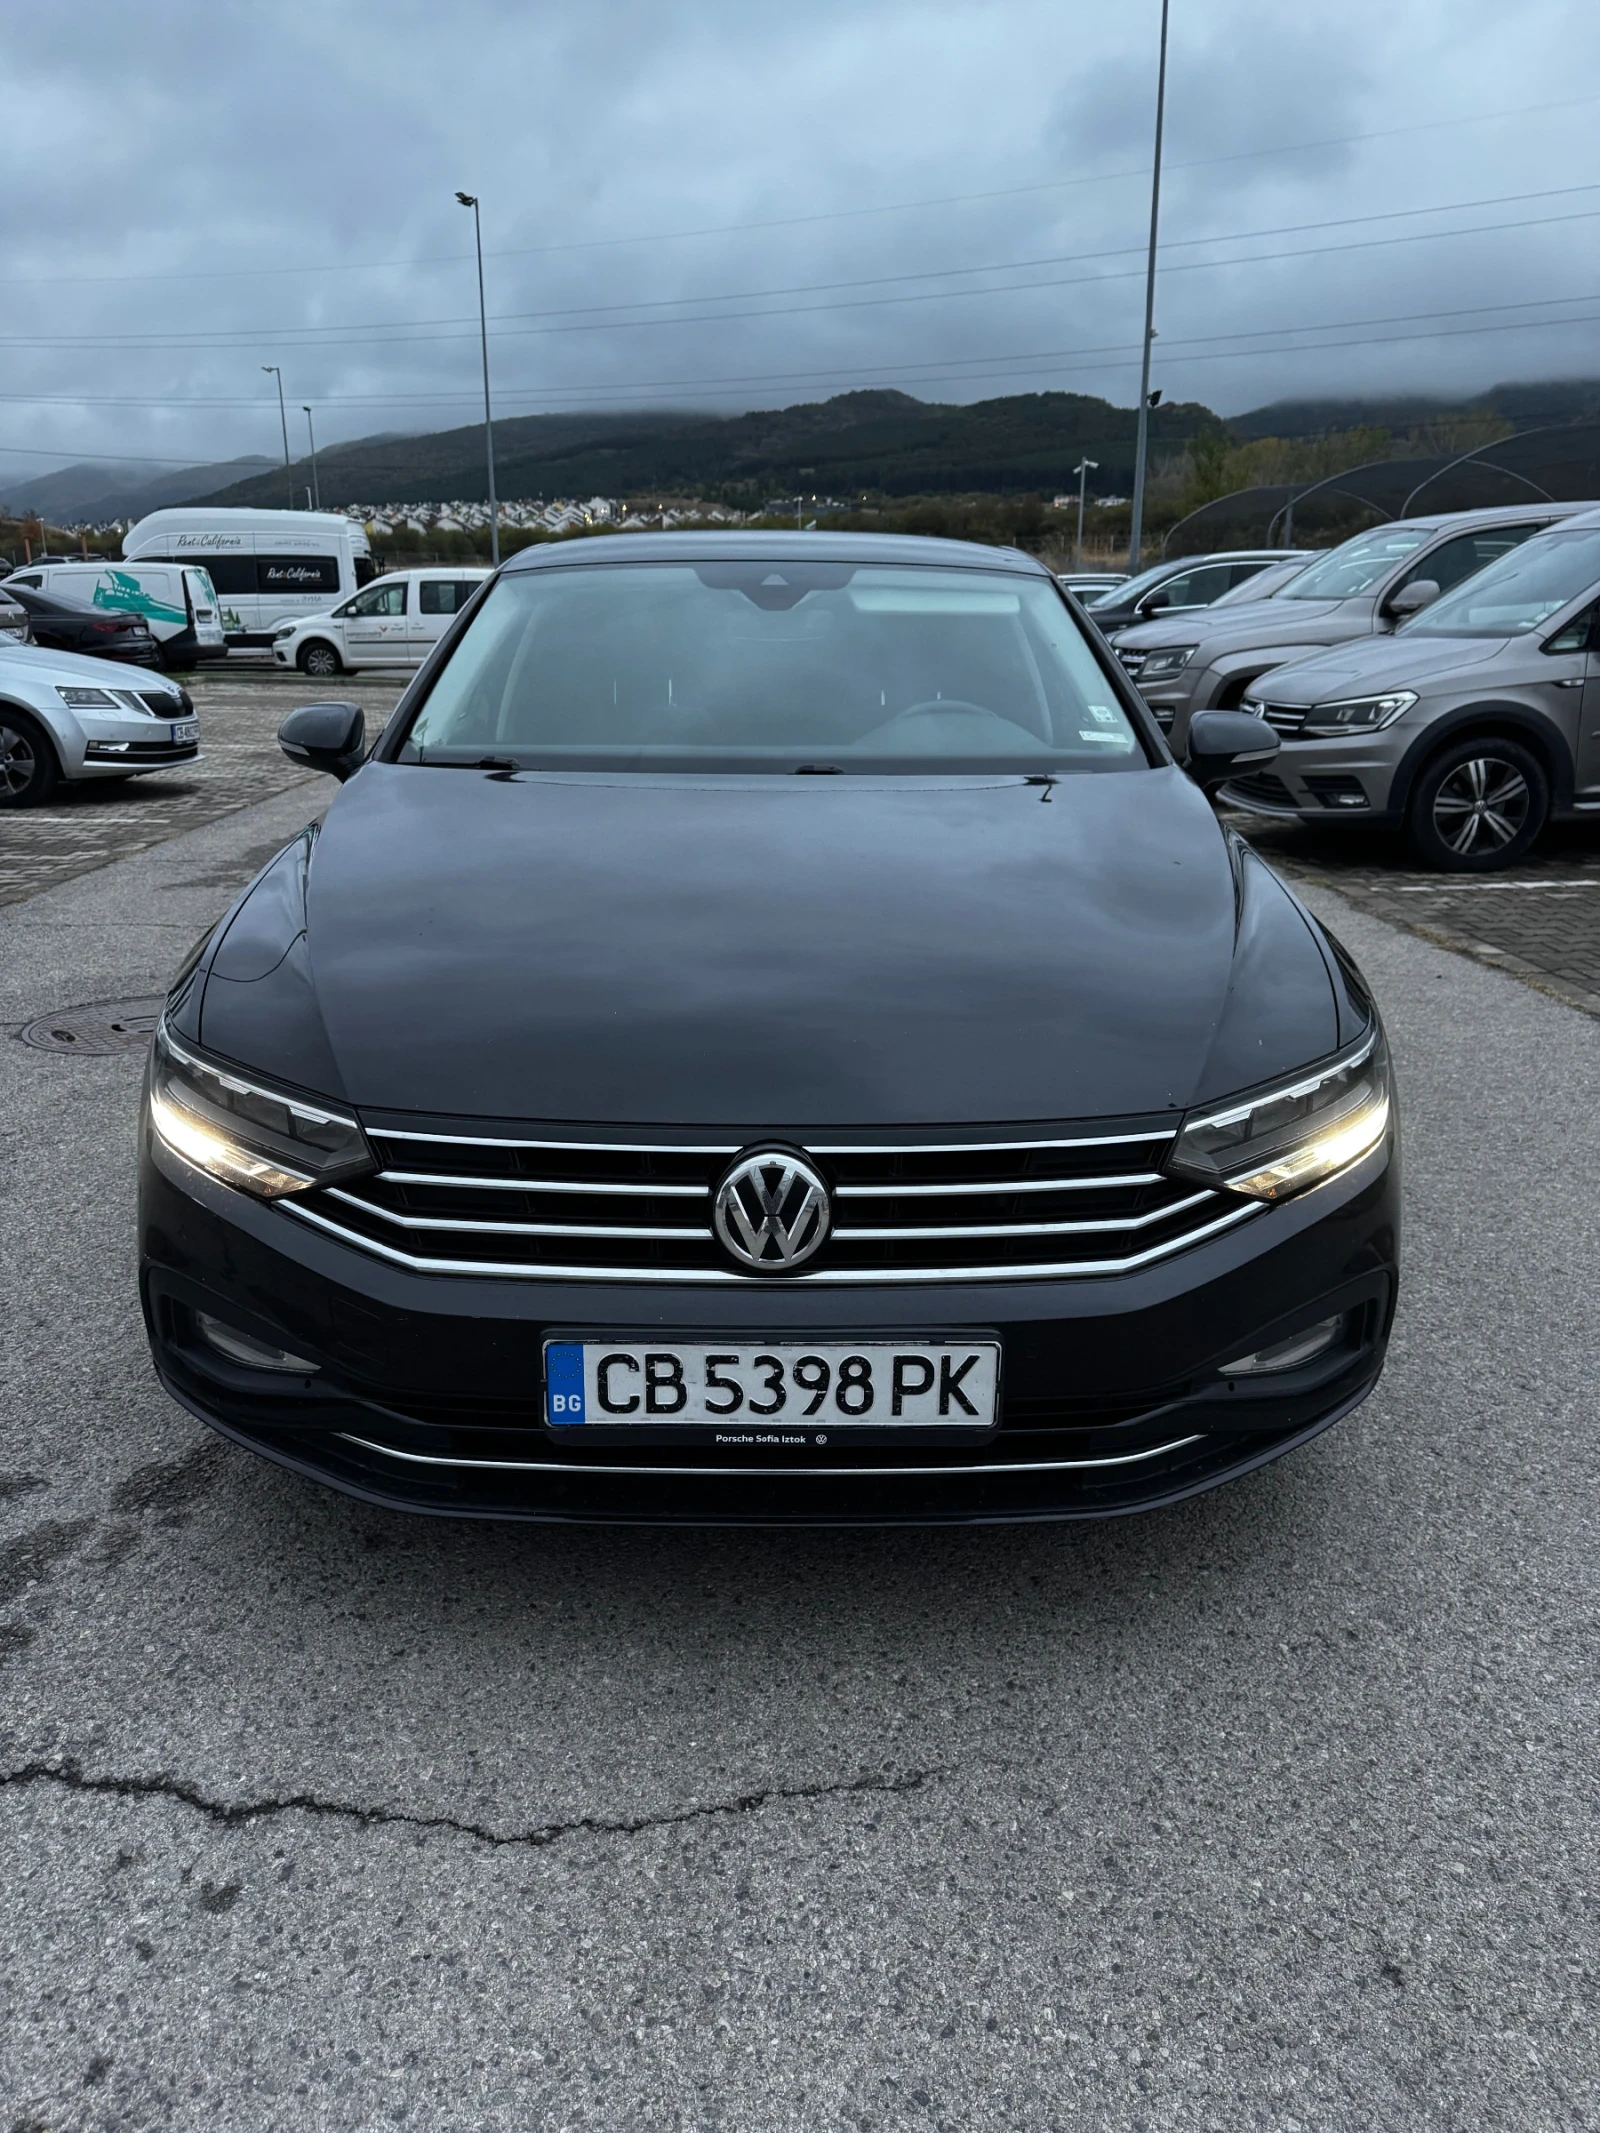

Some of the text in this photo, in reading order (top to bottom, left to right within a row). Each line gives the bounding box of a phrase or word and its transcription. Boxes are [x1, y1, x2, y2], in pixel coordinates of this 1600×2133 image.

[177, 534, 196, 547] Rent
[200, 533, 241, 549] California
[266, 567, 283, 579] Rent
[286, 566, 321, 582] California
[597, 1353, 981, 1416] CB 5398 PK
[553, 1394, 582, 1413] BG
[716, 1434, 754, 1443] Porsche
[755, 1434, 780, 1443] Sofia
[781, 1435, 806, 1444] Iztok
